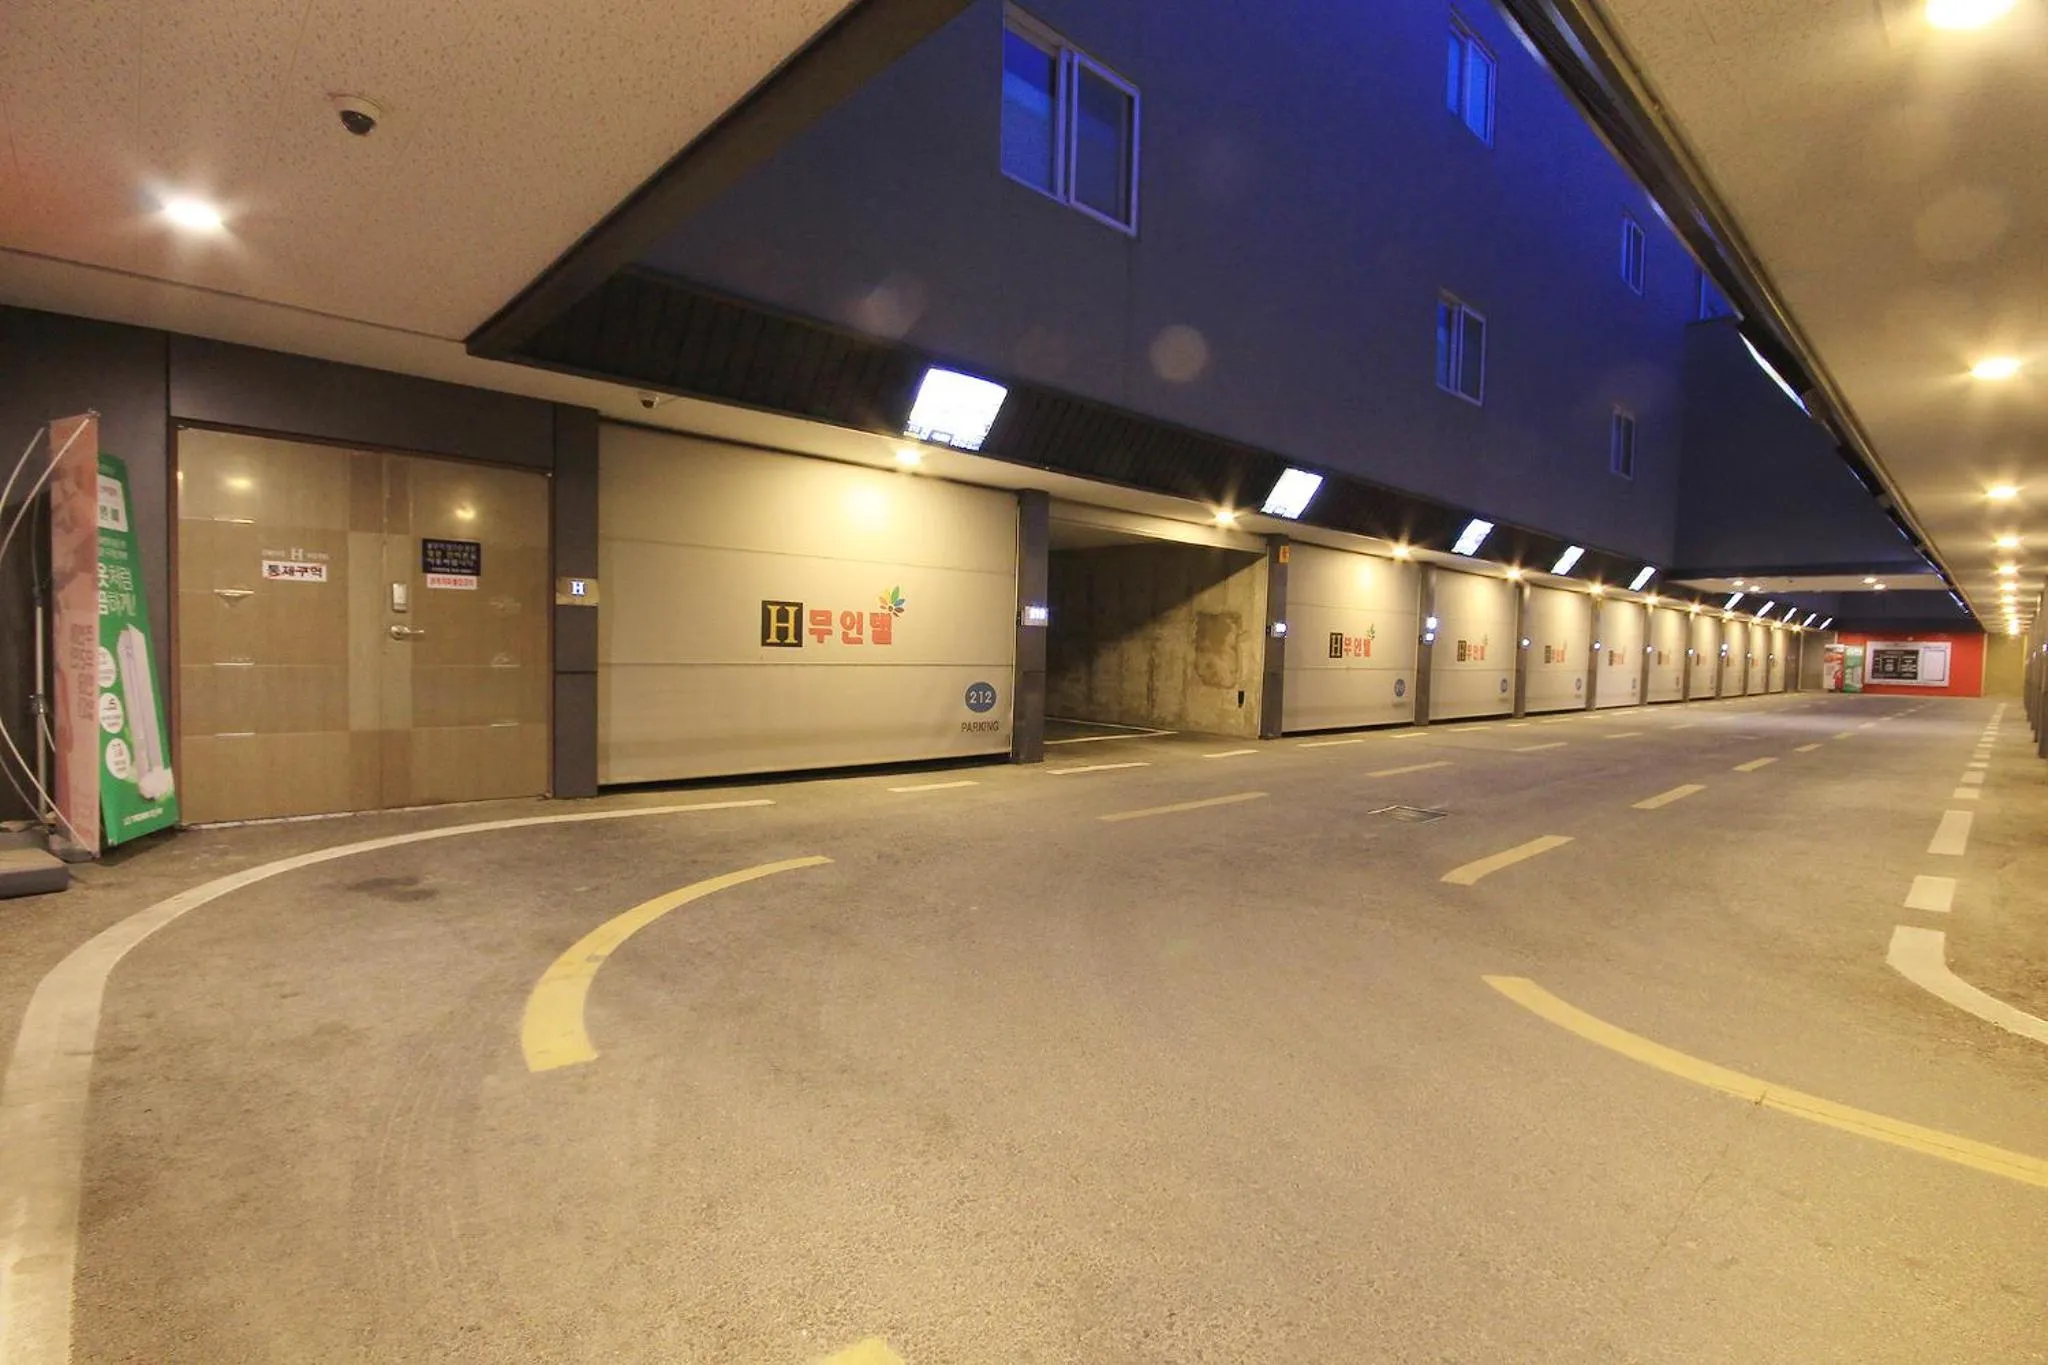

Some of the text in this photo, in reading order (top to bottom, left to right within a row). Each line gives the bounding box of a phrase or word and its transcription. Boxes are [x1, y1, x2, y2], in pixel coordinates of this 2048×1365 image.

[571, 580, 585, 597] H
[765, 604, 893, 645] H 무인텔
[1330, 634, 1342, 657] H
[969, 690, 992, 705] 212
[961, 720, 999, 733] PARKING
